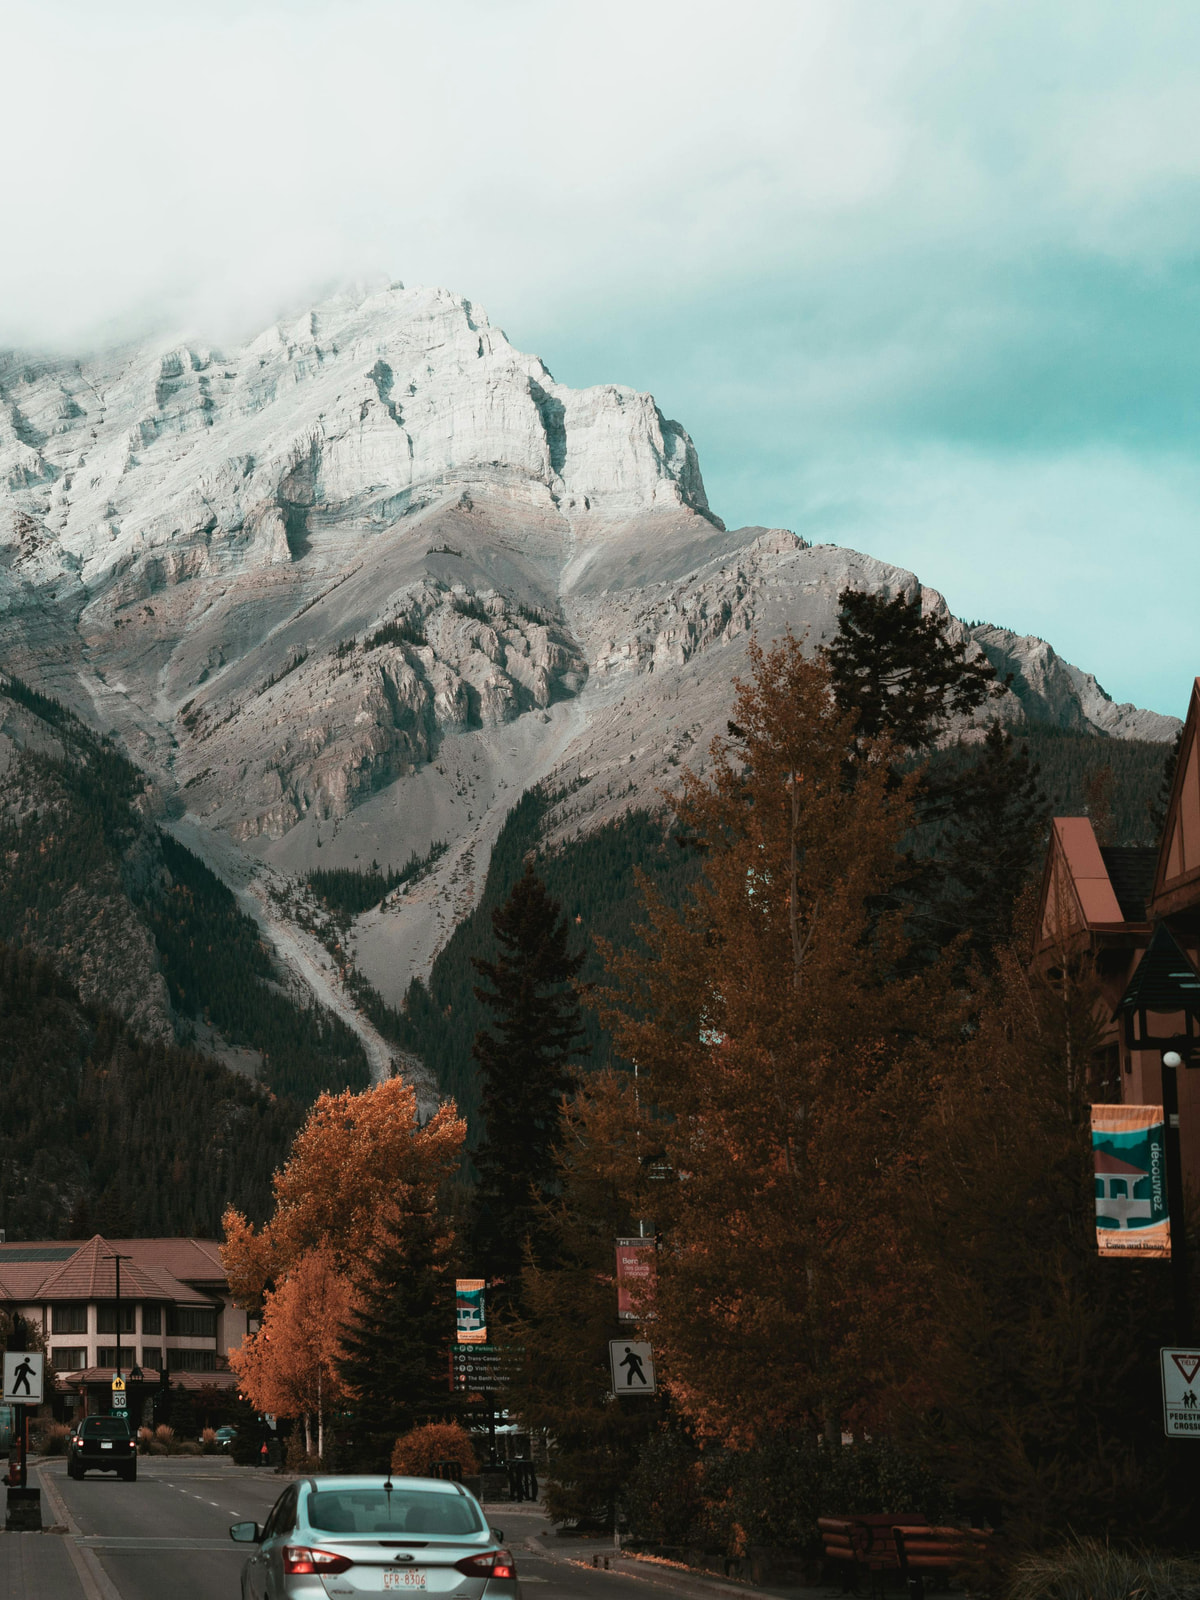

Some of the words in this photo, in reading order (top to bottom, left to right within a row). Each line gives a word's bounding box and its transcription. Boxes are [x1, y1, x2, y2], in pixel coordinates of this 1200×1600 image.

[1150, 1142, 1163, 1212] découvrez
[114, 1397, 126, 1406] 30
[383, 1574, 426, 1585] CFR-8306
